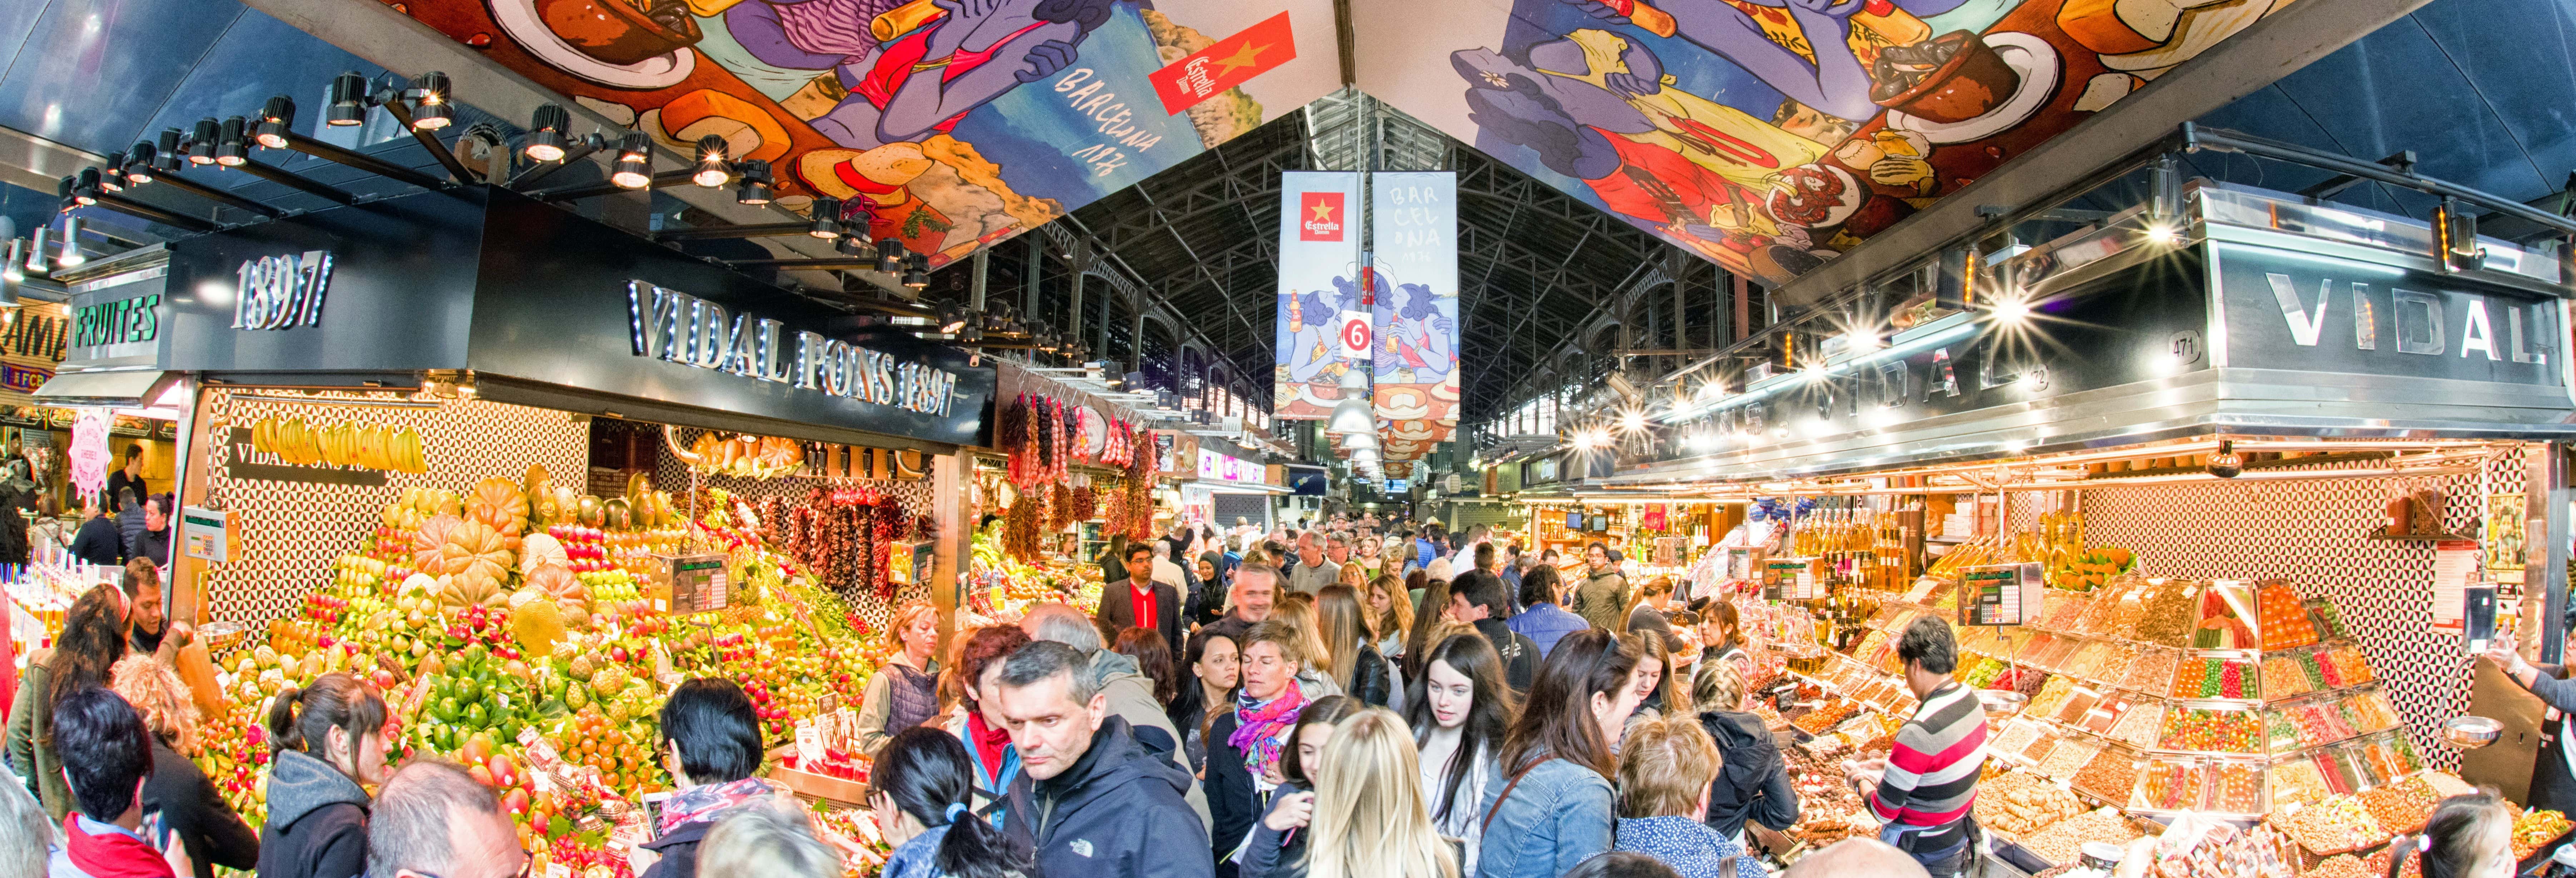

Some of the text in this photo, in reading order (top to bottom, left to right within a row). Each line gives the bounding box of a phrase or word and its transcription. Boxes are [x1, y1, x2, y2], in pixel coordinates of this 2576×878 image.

[1176, 76, 1189, 94] Damm
[1184, 56, 1217, 98] Estrella
[1055, 68, 1162, 153] BARCELONA
[1072, 144, 1128, 177] 1876
[1389, 185, 1438, 205] BAR
[1305, 220, 1339, 231] Estrella
[1393, 209, 1439, 227] CEL
[1394, 228, 1441, 248] ONA
[231, 250, 333, 331] 1897
[75, 294, 160, 348] FRUITES
[2265, 272, 2546, 365] VIDAL
[1351, 324, 1364, 346] 6
[624, 279, 957, 418] VIDAL PONS 1897
[2173, 337, 2194, 358] 471
[2031, 369, 2045, 385] 72
